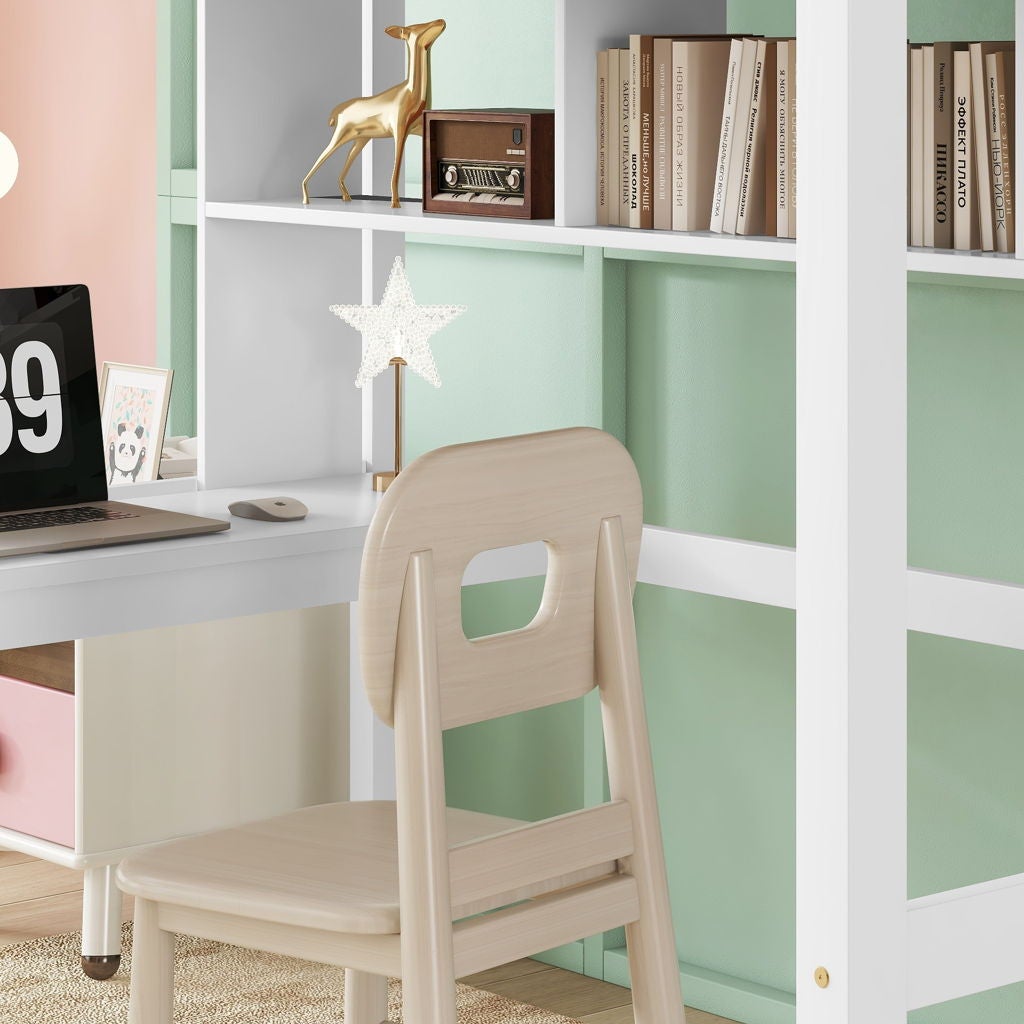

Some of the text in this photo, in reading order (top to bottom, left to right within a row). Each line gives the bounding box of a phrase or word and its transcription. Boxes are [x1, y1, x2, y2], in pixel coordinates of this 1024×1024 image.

[676, 66, 684, 112] НОВЫЙ
[748, 108, 757, 142] Религия
[622, 136, 630, 204] ПРЕДАННЫХ
[957, 97, 967, 208] ЭФФЕКТ ПЛАТО
[642, 174, 650, 211] ЛУЧШЕ
[714, 183, 723, 217] ВОСТОКА
[739, 174, 749, 217] водолазки
[936, 143, 947, 223] ПИКАССО
